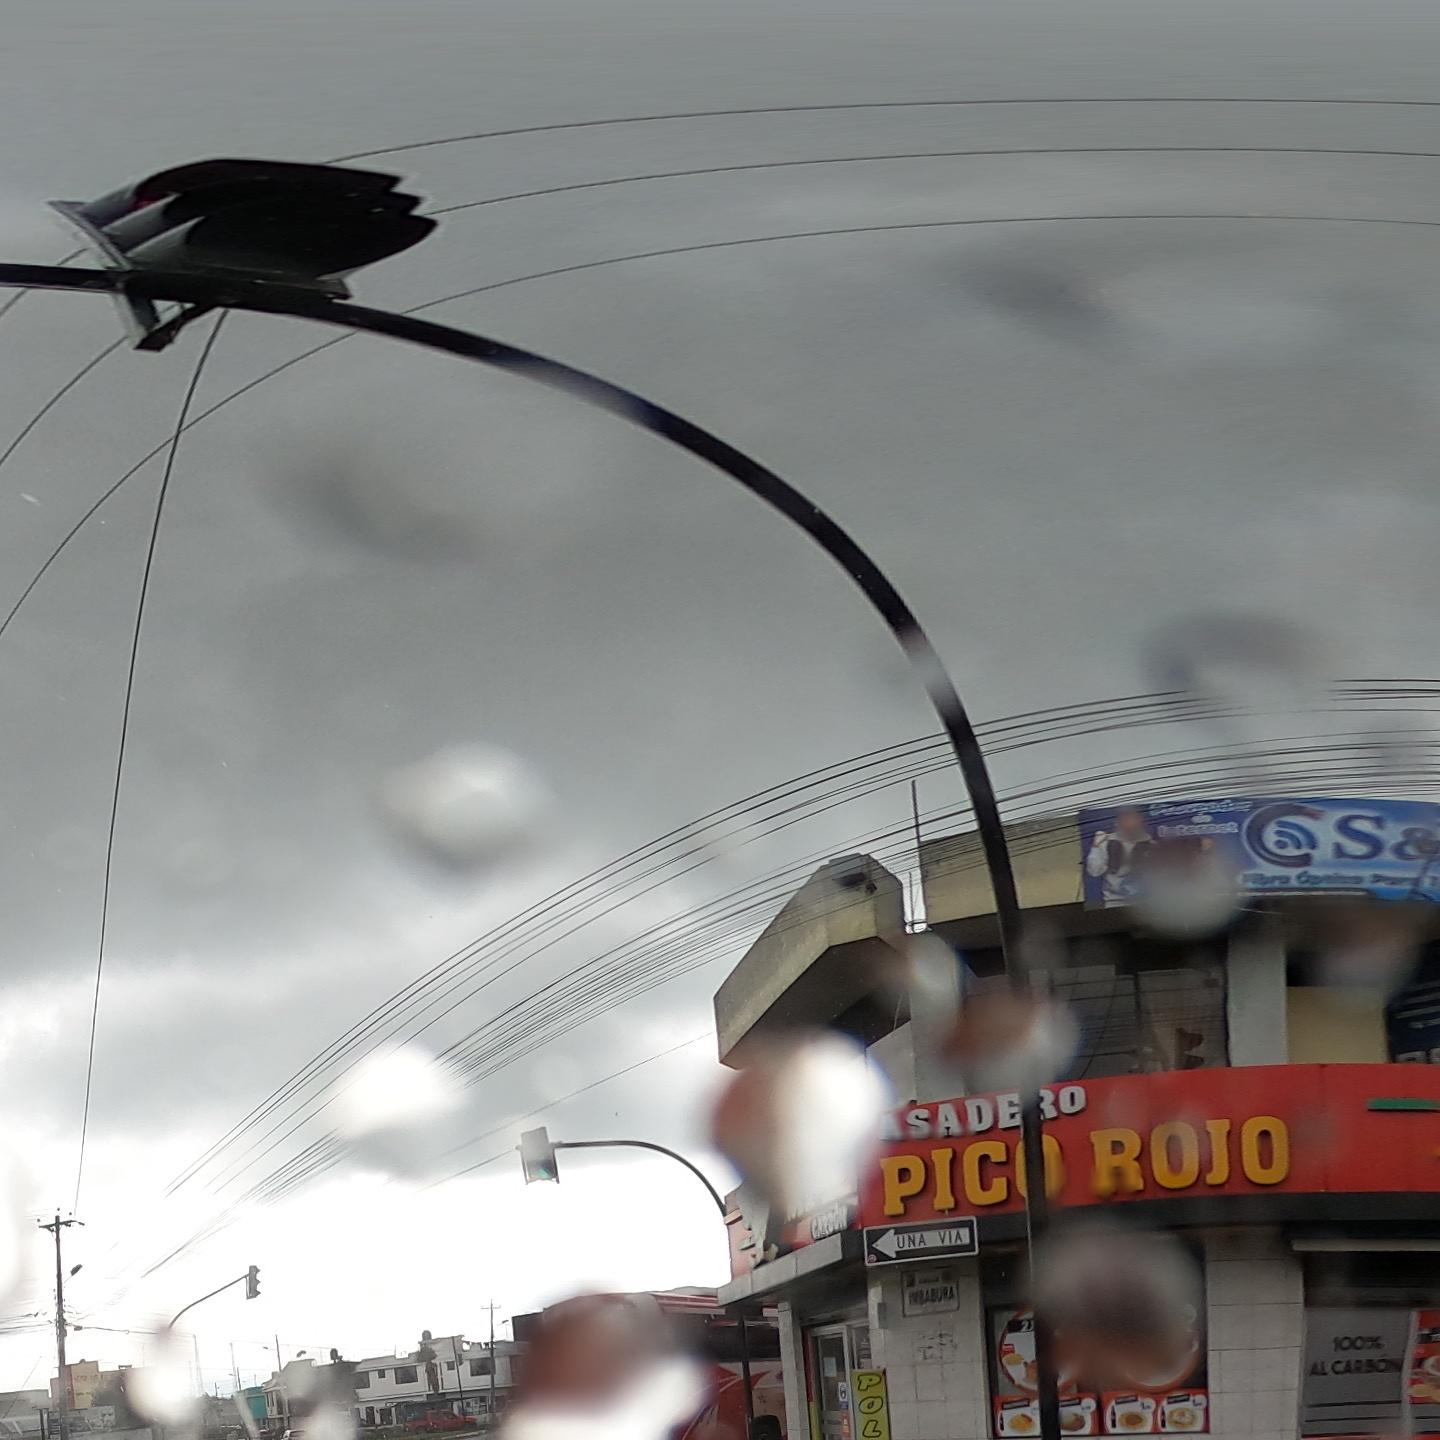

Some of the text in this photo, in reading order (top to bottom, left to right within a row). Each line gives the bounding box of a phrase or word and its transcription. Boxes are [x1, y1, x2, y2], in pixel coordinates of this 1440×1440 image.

[880, 1116, 1291, 1217] PICO ROJO
[896, 1229, 963, 1249] UNA VIA
[1332, 1335, 1386, 1351] 100%
[1309, 1360, 1328, 1376] AL
